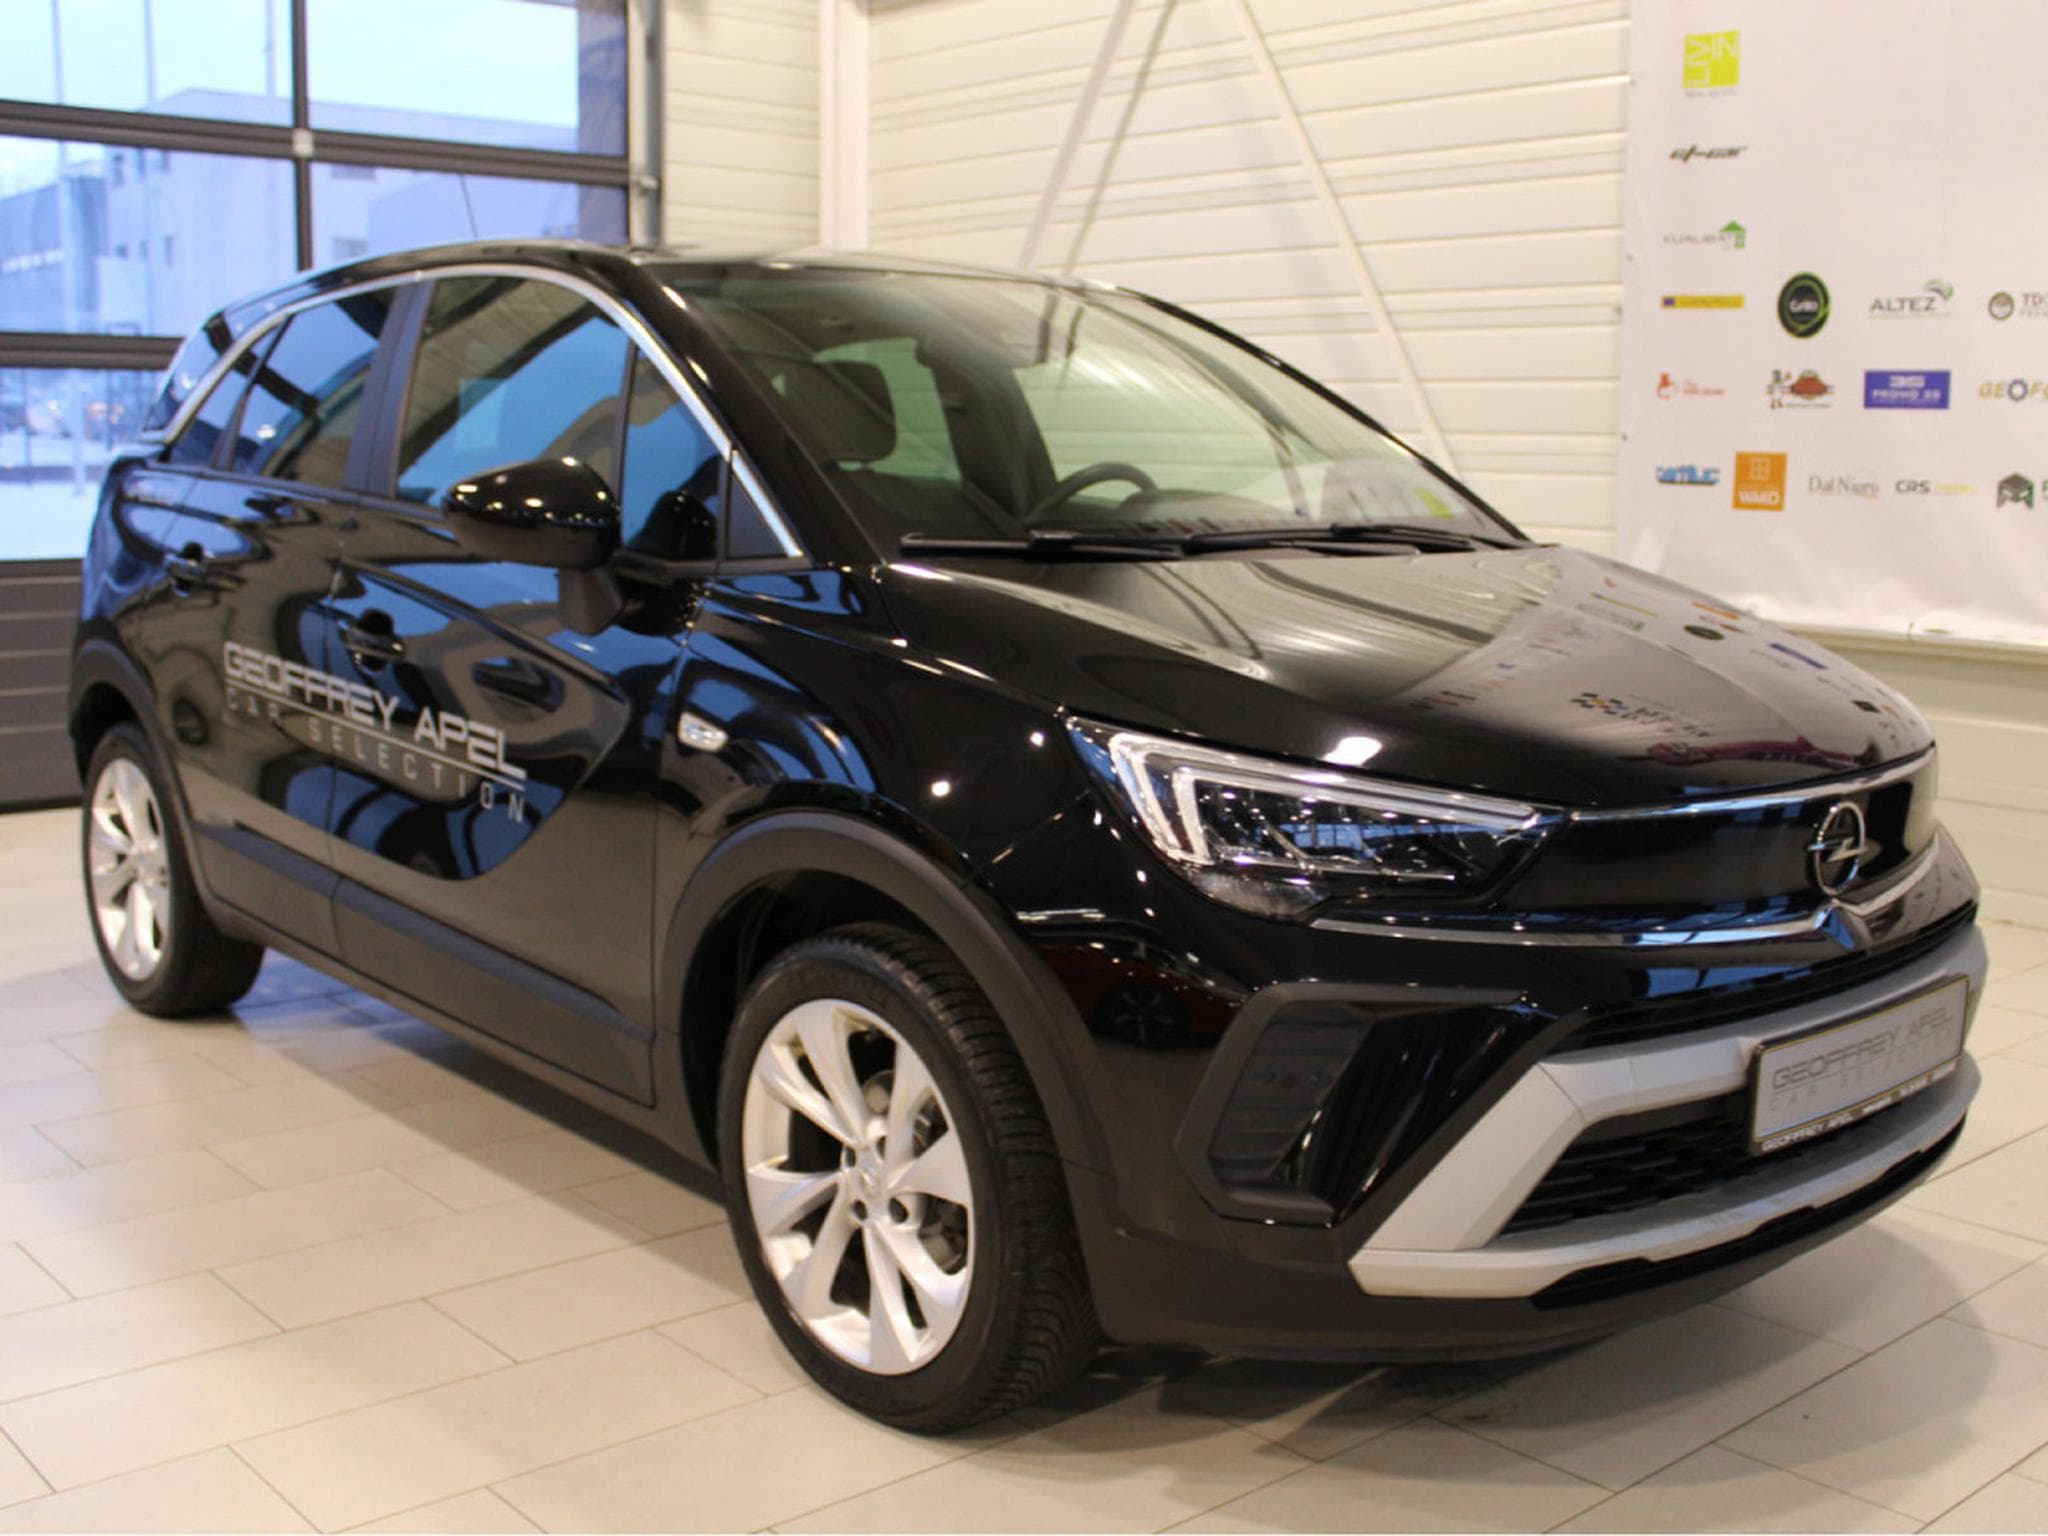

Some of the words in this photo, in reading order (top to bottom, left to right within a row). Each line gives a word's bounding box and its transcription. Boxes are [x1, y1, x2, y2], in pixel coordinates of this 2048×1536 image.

[1870, 297, 1936, 312] ALTEZ
[223, 641, 400, 733] GEOFFREY
[413, 706, 527, 781] APEL
[226, 687, 282, 723] CAR
[307, 716, 526, 823] SELECTION
[1773, 1026, 1901, 1091] GEOFFREY
[1907, 1007, 1953, 1036] APEL
[1760, 1120, 1829, 1152] GEOFFREY
